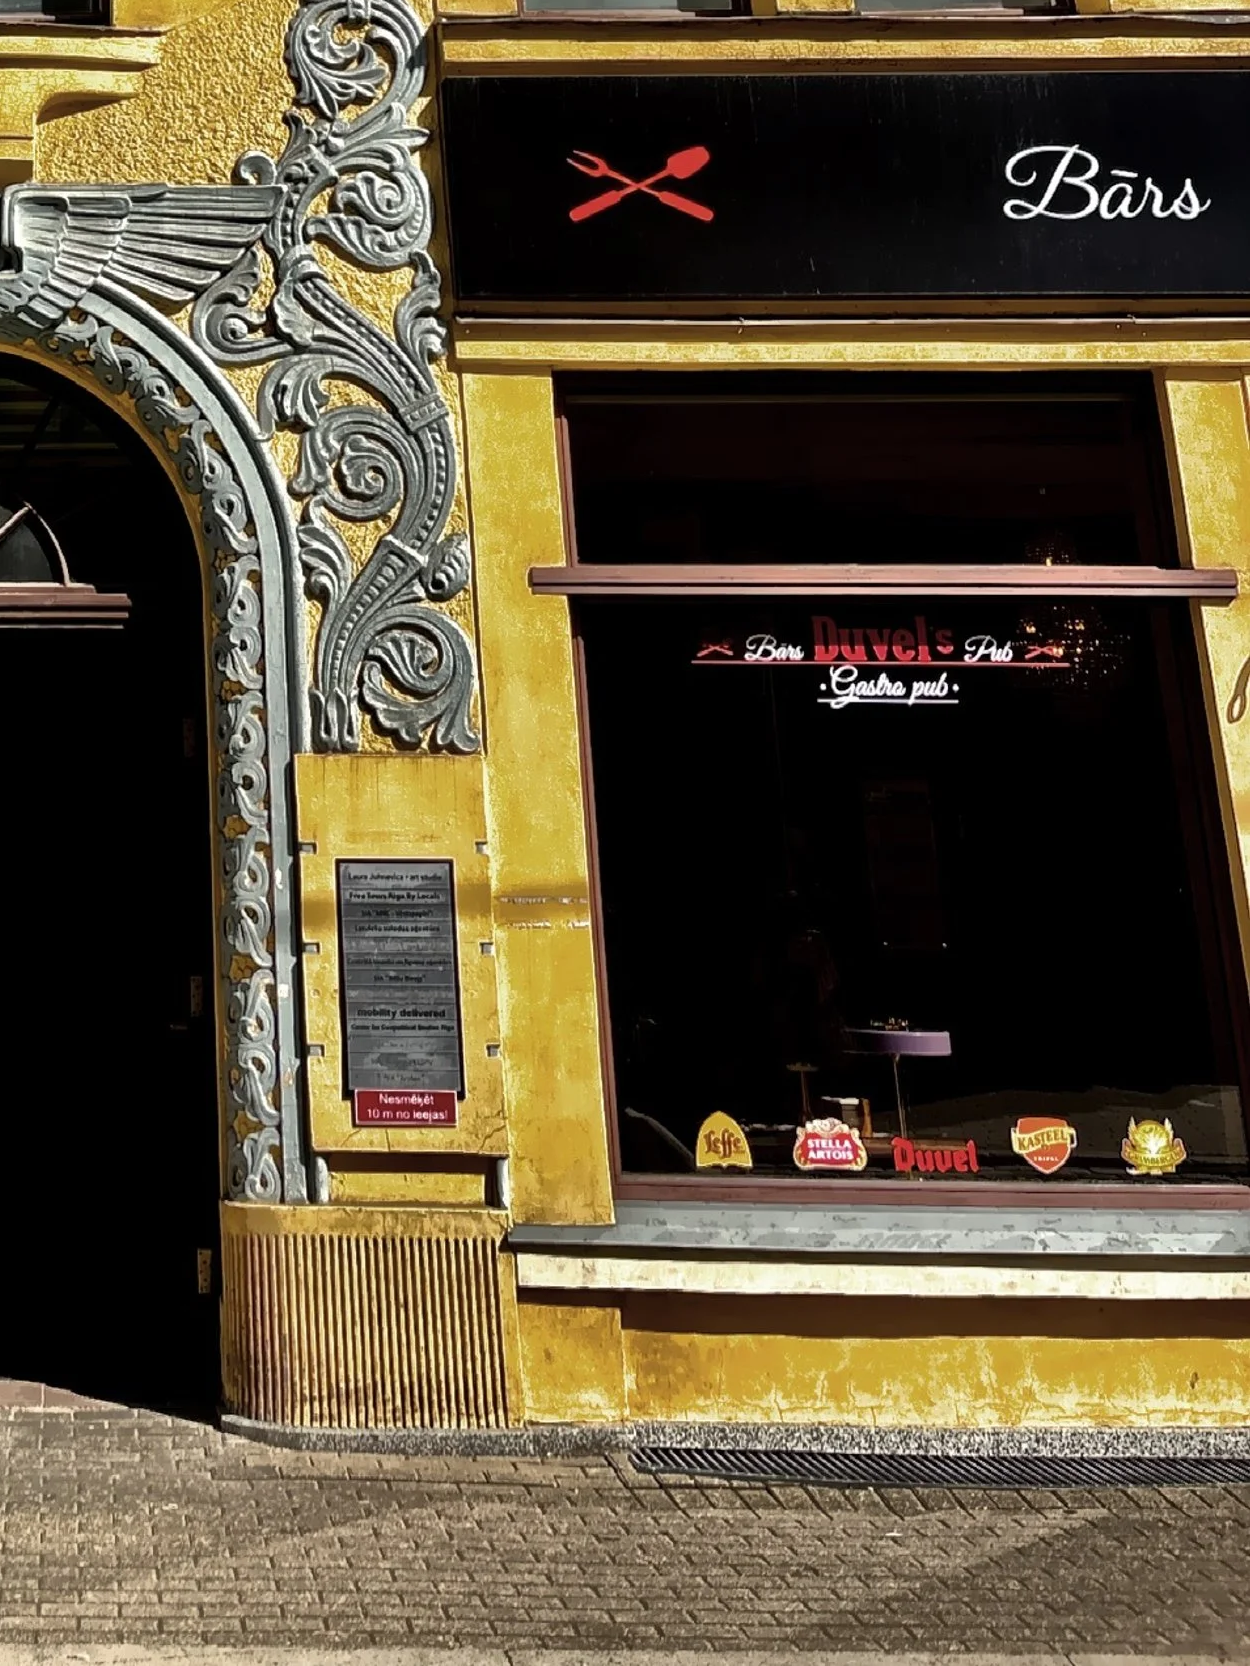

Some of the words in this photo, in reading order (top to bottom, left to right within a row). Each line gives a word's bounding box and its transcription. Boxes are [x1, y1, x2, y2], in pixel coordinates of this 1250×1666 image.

[1003, 144, 1211, 220] Bārs
[744, 634, 804, 662] Bārs
[811, 615, 955, 663] Duvel's
[963, 635, 1014, 663] Pub
[830, 665, 906, 709] Gastro
[909, 672, 949, 705] pub
[350, 891, 365, 899] Free
[417, 891, 440, 899] Locals
[357, 1008, 397, 1020] mobility
[400, 1007, 446, 1018] delivered
[379, 1092, 435, 1107] Nesmēķēt
[367, 1108, 379, 1119] 10
[383, 1111, 393, 1119] m
[396, 1111, 410, 1119] no
[807, 1138, 852, 1149] STELLA
[1018, 1128, 1068, 1151] KASTEEL
[807, 1149, 854, 1160] ARTOIS
[891, 1136, 979, 1173] Duvel
